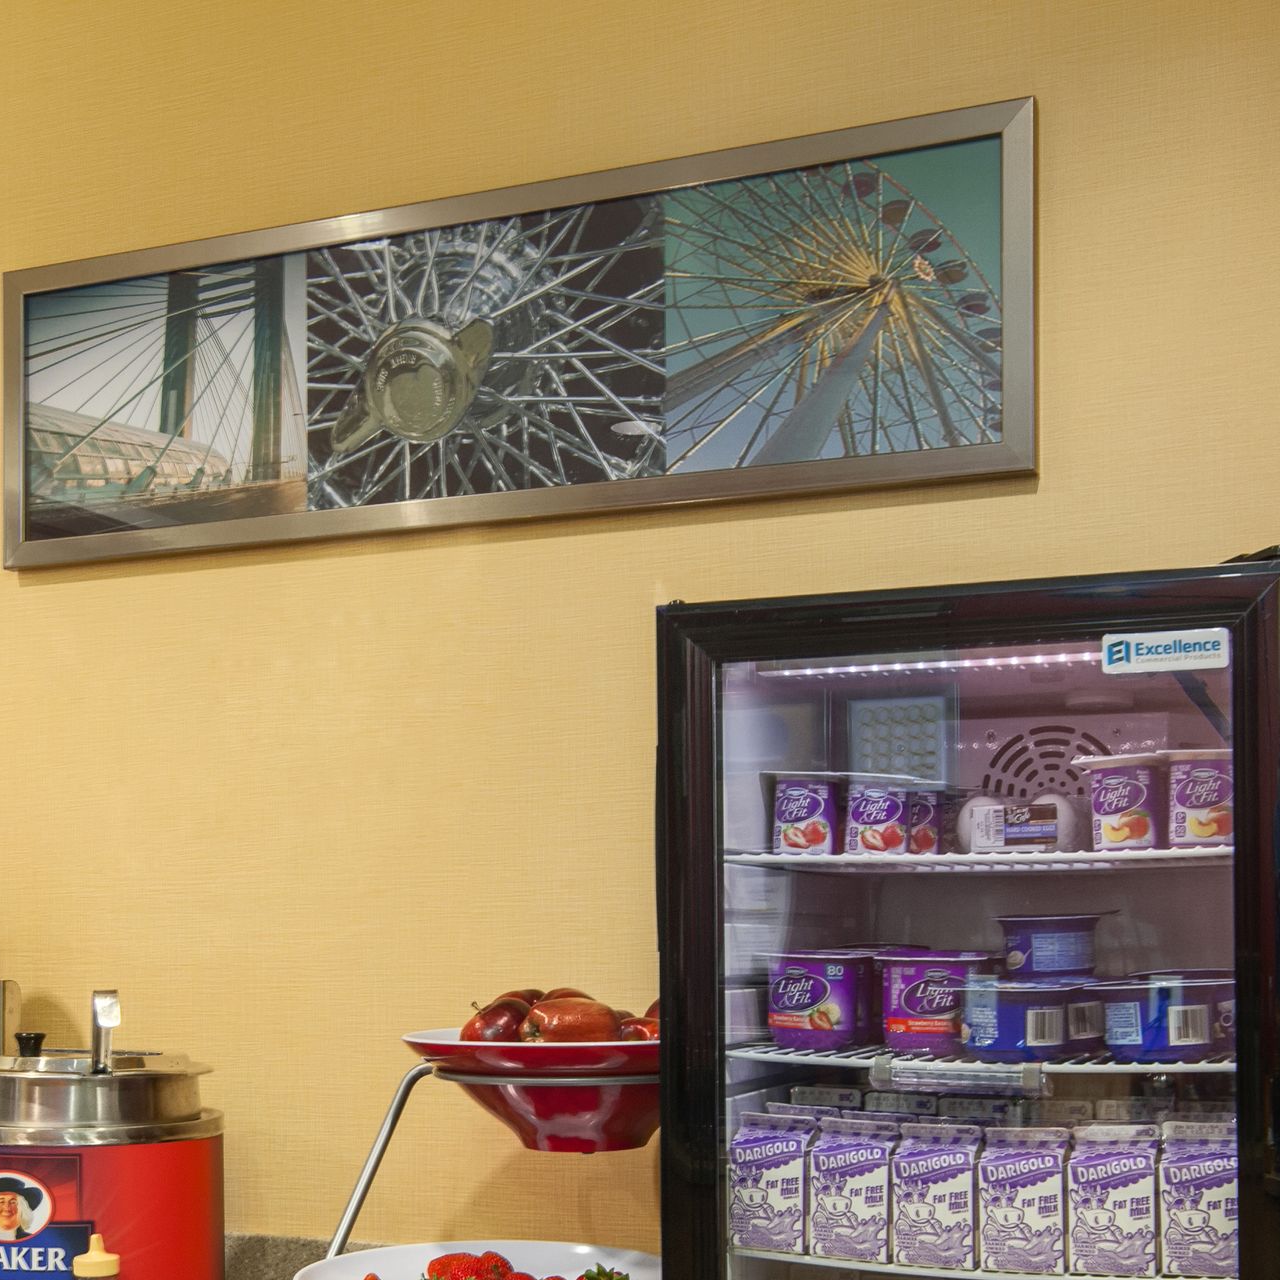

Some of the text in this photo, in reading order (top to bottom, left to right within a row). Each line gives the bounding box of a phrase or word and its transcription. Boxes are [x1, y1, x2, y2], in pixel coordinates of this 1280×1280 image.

[1134, 639, 1221, 656] Excellence
[1100, 785, 1131, 802] Light
[1186, 780, 1221, 795] Light
[782, 797, 810, 811] Light
[1112, 797, 1129, 809] Fit
[1200, 792, 1219, 803] Fit
[792, 808, 808, 817] Fit
[859, 799, 890, 813] Light
[870, 810, 888, 820] Fit
[827, 966, 844, 976] 80
[778, 978, 814, 996] Light
[792, 992, 811, 1004] Fit
[933, 994, 953, 1007] Fit
[736, 1141, 797, 1163] DARIGOLD
[820, 1148, 882, 1171] DARIGOLD
[900, 1153, 965, 1177] DARIGOLD
[987, 1156, 1054, 1181] DARIGOLD
[1077, 1157, 1147, 1182] DARIGOLD
[766, 1177, 799, 1189] FAT FREE
[780, 1187, 799, 1196] MILK
[850, 1185, 884, 1197] FAT FREE
[933, 1191, 968, 1204] FAT FREE
[864, 1195, 883, 1204] MILK
[948, 1200, 968, 1211] MILK
[1022, 1194, 1058, 1208] FAT FREE
[1113, 1196, 1150, 1210] FAT FREE
[1207, 1200, 1222, 1210] FAT
[1038, 1204, 1058, 1215] MILK
[1130, 1206, 1150, 1217] MILK
